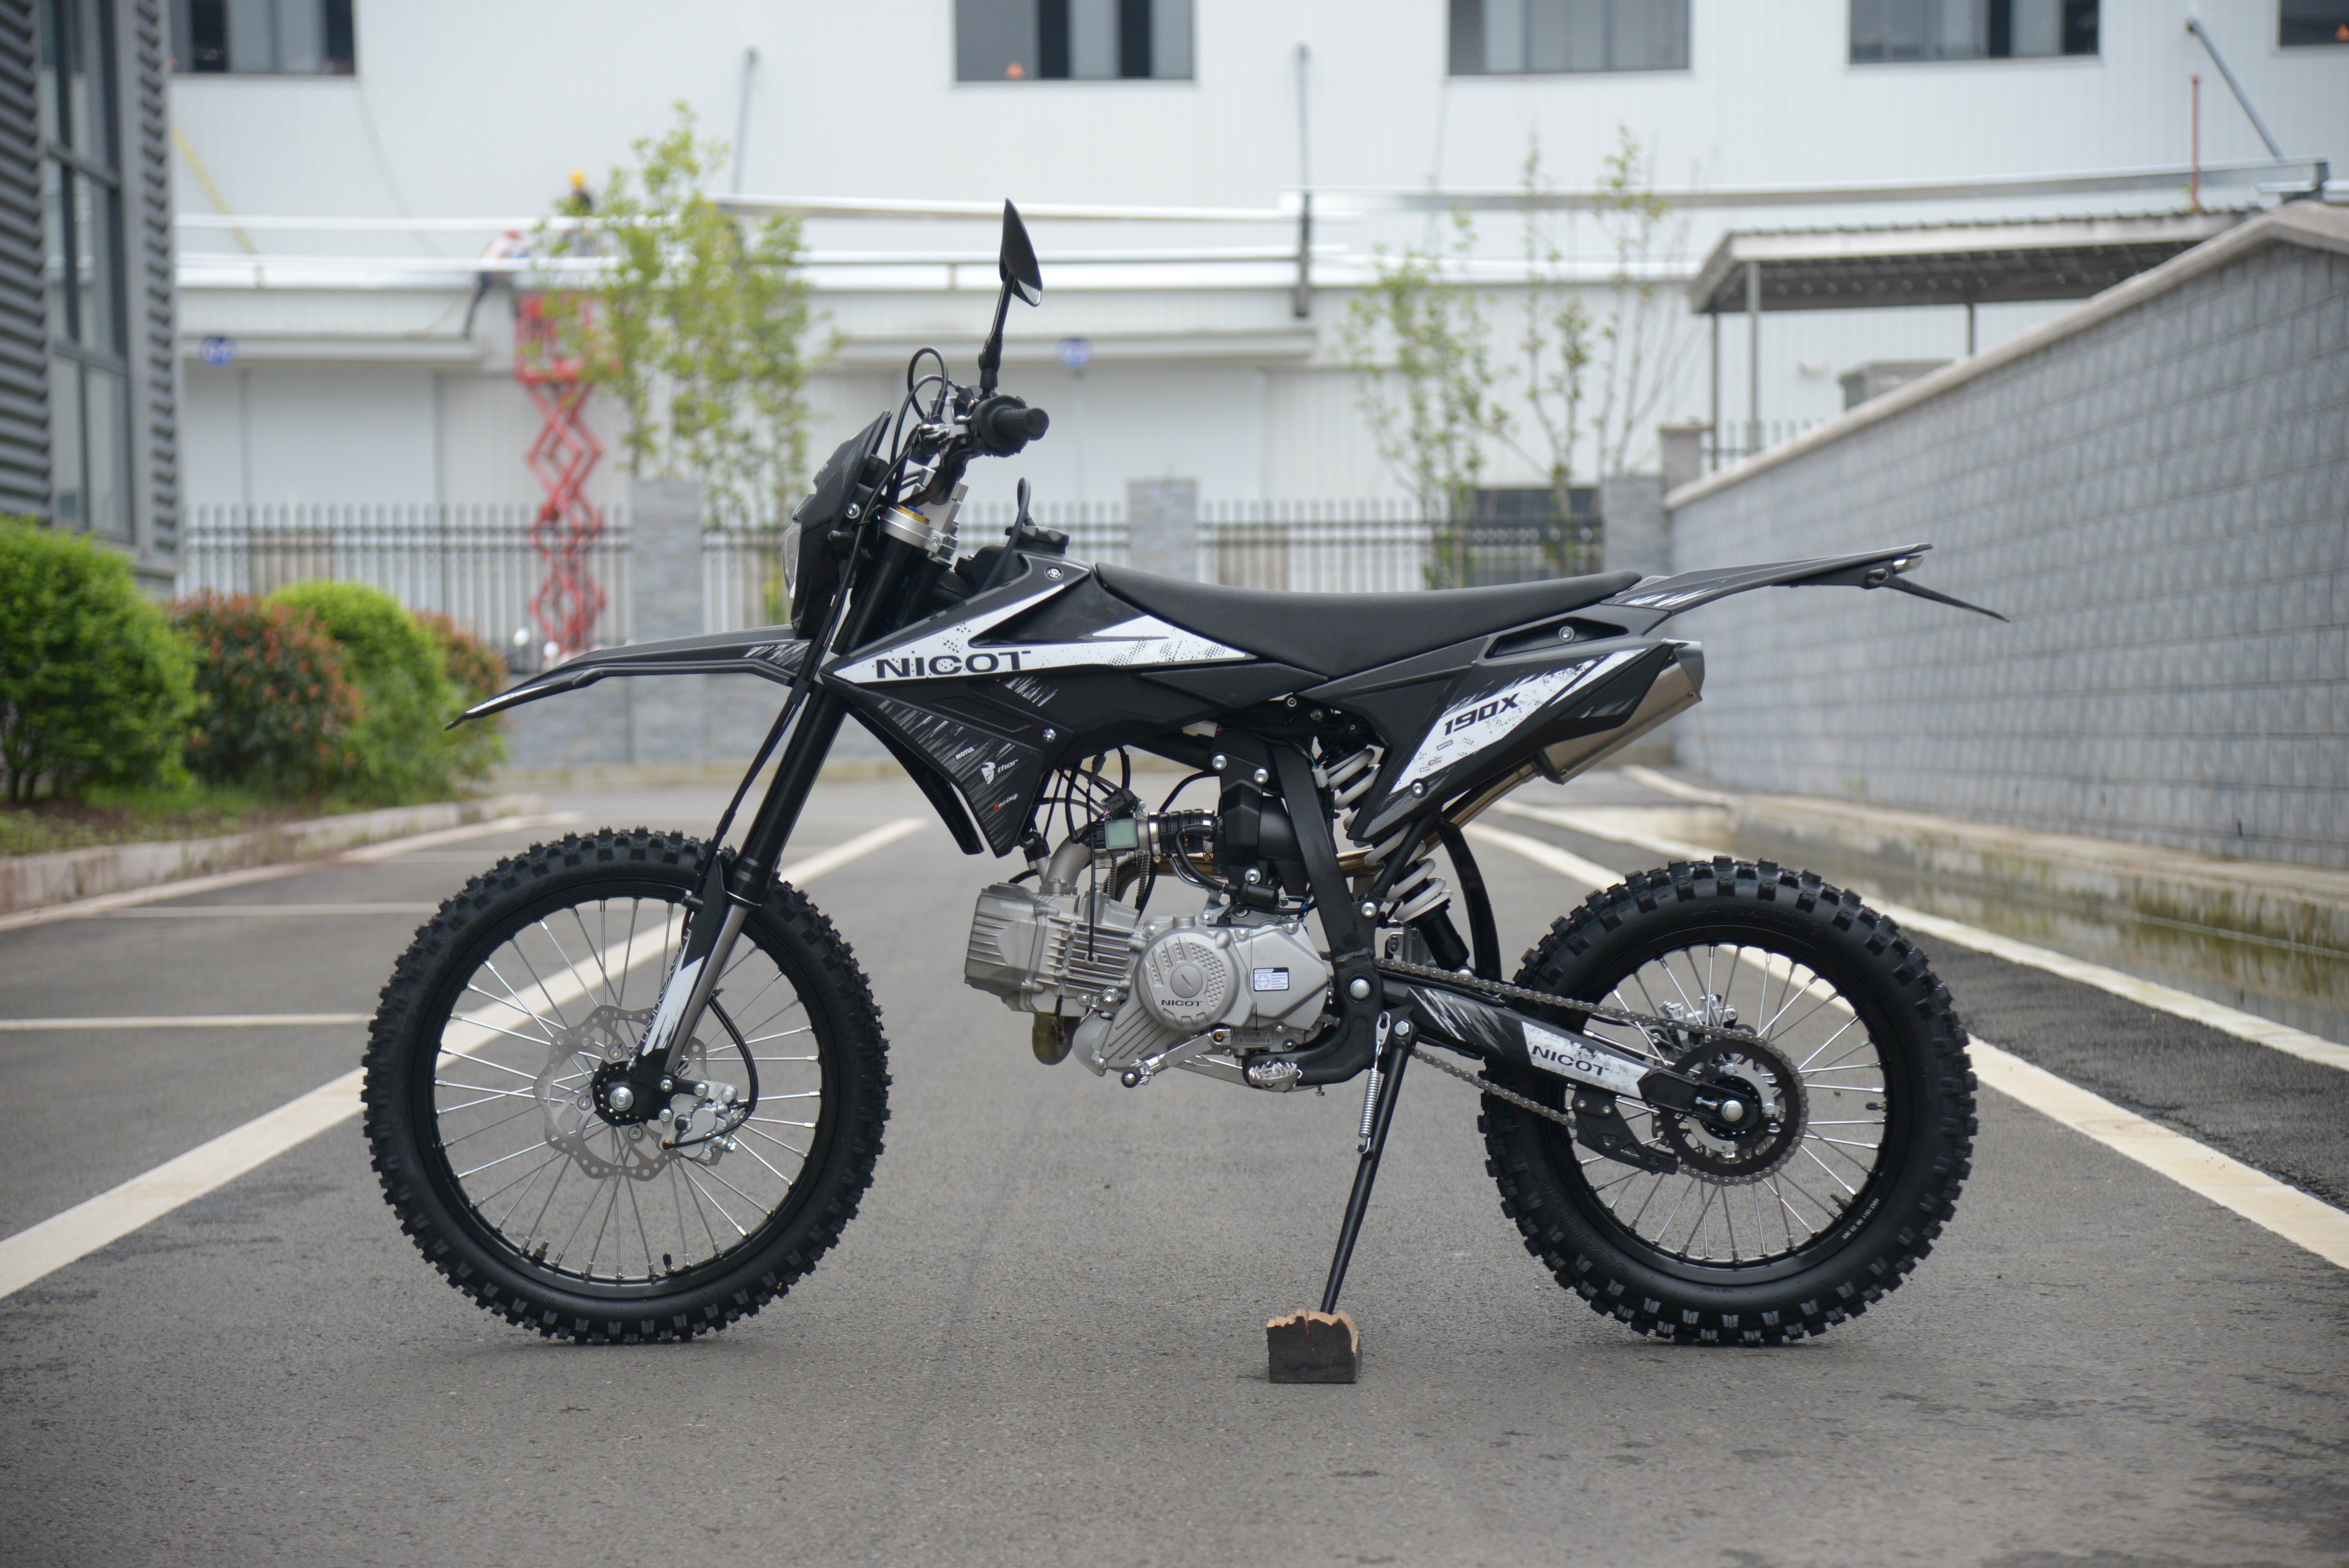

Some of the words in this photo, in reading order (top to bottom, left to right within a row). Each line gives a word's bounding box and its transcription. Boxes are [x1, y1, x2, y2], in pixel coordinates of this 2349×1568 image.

[876, 650, 1031, 679] NICOT
[1445, 692, 1520, 736] 190X
[955, 746, 975, 760] MOTUL
[993, 793, 1018, 811] Racing
[1532, 1045, 1609, 1076] NICOT
